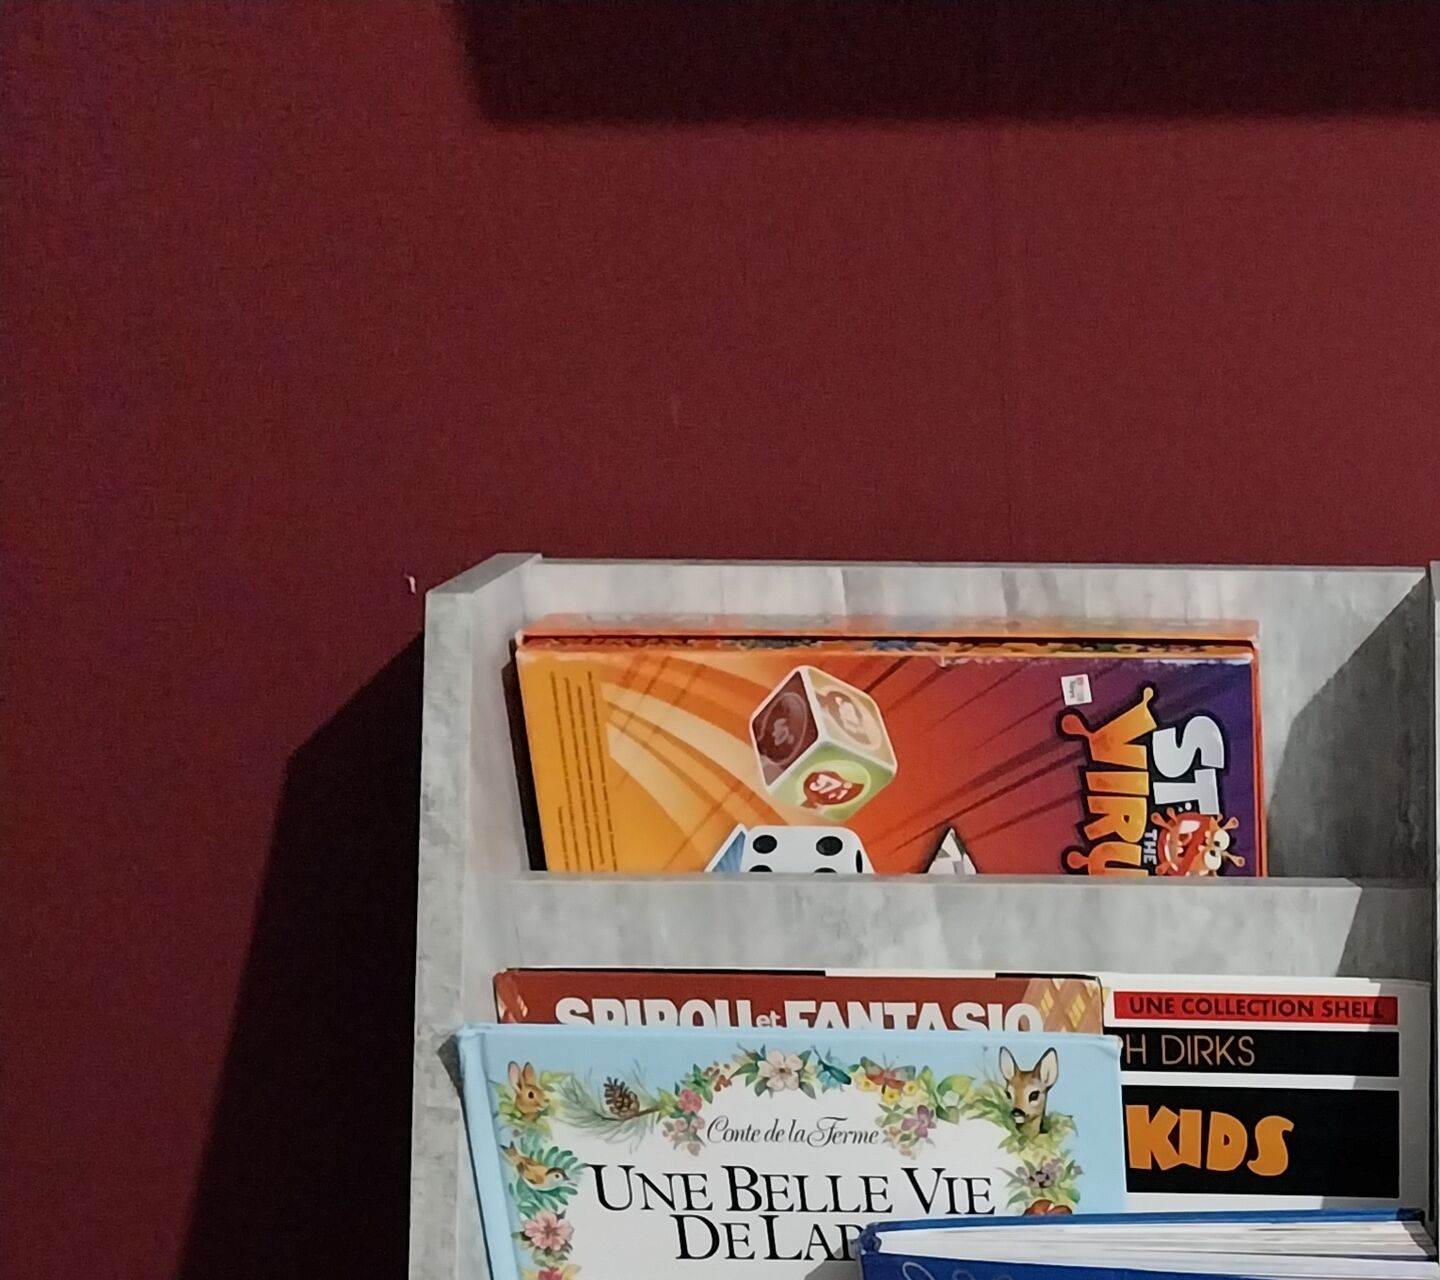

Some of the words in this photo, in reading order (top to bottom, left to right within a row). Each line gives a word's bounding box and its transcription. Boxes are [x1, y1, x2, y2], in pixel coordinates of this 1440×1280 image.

[1143, 829, 1158, 866] THE
[1130, 994, 1174, 1015] UNE
[1182, 996, 1313, 1018] COLLECTION
[1321, 1000, 1384, 1020] SHELL
[1163, 1035, 1256, 1067] DIRKS
[707, 1115, 761, 1145] Conte
[765, 1116, 787, 1145] de
[788, 1118, 806, 1145] la
[807, 1115, 880, 1148] Ferme
[1126, 1104, 1295, 1177] KIDS
[585, 1163, 713, 1212] UNE
[721, 1165, 893, 1214] BELLE
[901, 1167, 996, 1217] VIE
[670, 1214, 755, 1261] DE
